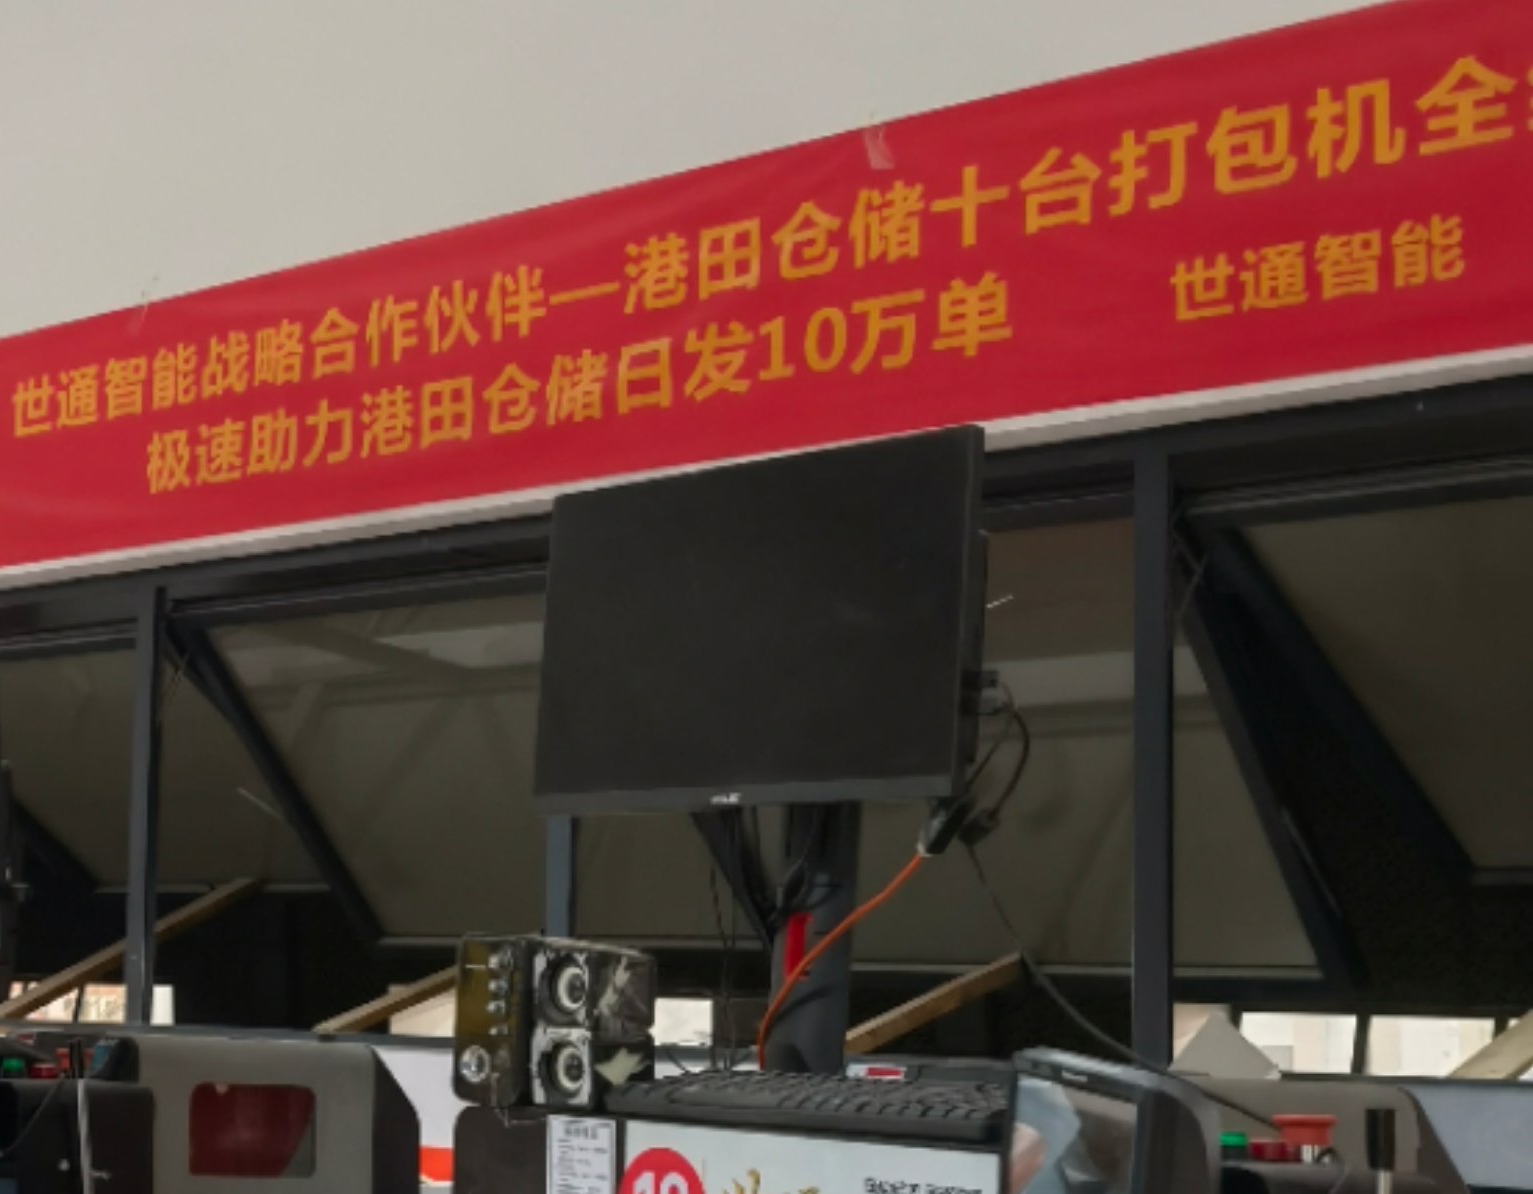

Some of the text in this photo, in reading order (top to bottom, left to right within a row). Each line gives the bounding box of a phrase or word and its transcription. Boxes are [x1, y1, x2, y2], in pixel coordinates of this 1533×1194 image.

[1169, 213, 1467, 324] 世通智能
[145, 270, 1014, 494] 极速助力港田仓储日发10万单
